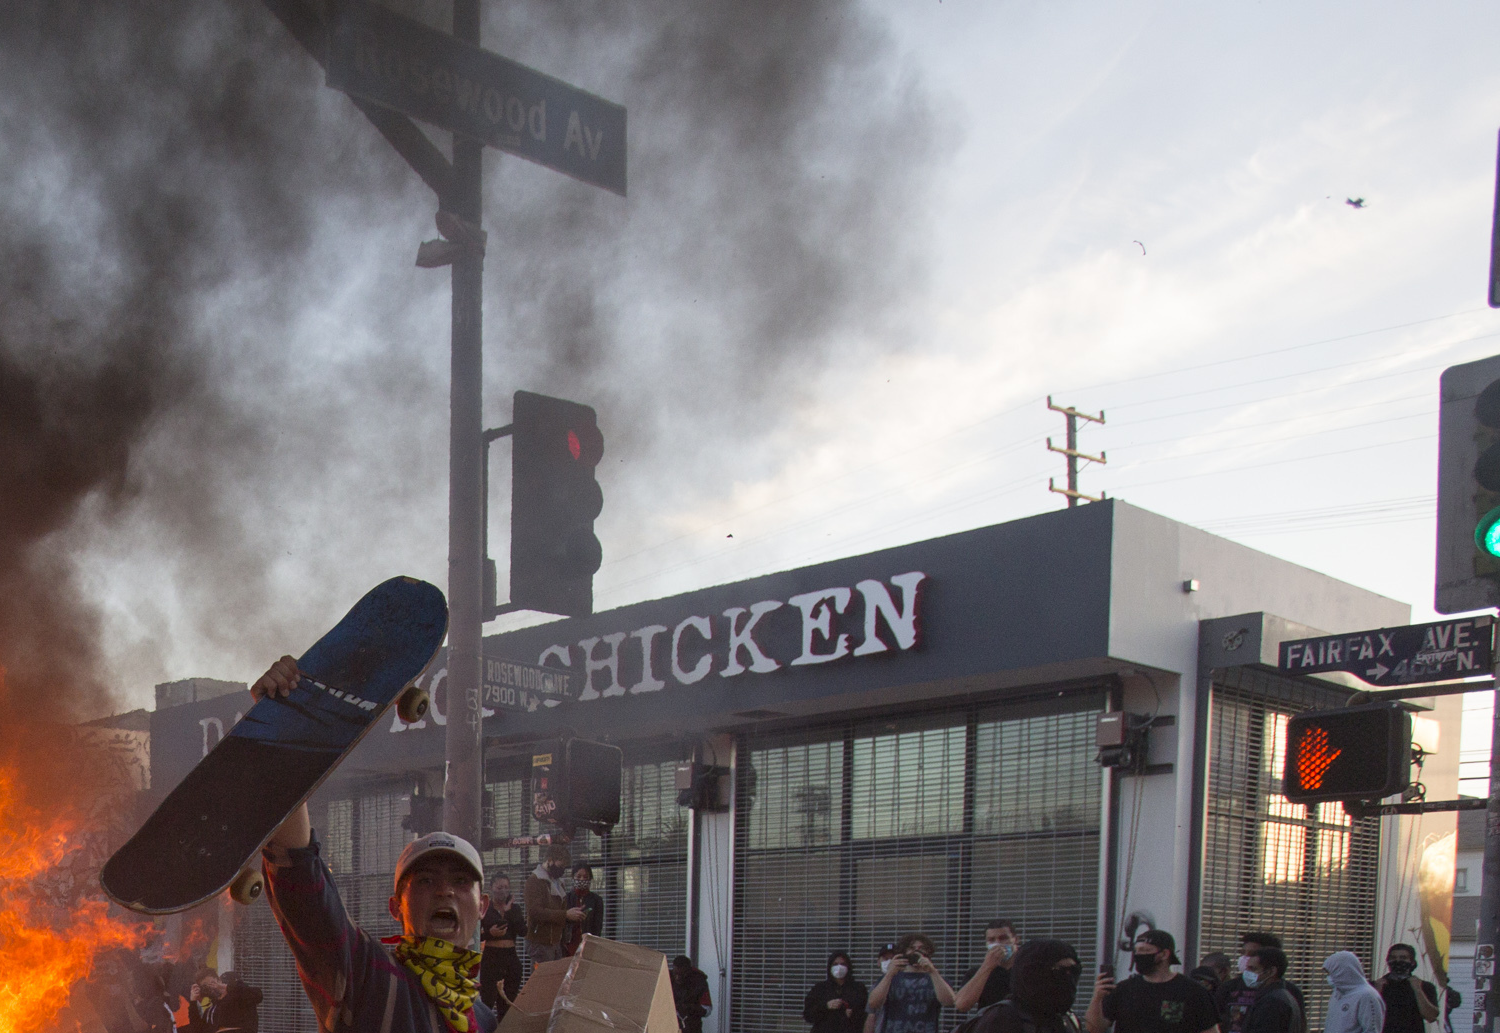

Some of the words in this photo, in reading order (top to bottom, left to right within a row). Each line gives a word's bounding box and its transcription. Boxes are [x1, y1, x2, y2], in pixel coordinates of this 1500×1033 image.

[563, 110, 603, 161] Av
[1286, 632, 1395, 669] FAIRFAX
[1422, 621, 1480, 650] AVE.
[1457, 650, 1481, 671] N.
[487, 659, 542, 691] ROSEWOOD
[484, 685, 516, 706] 7900
